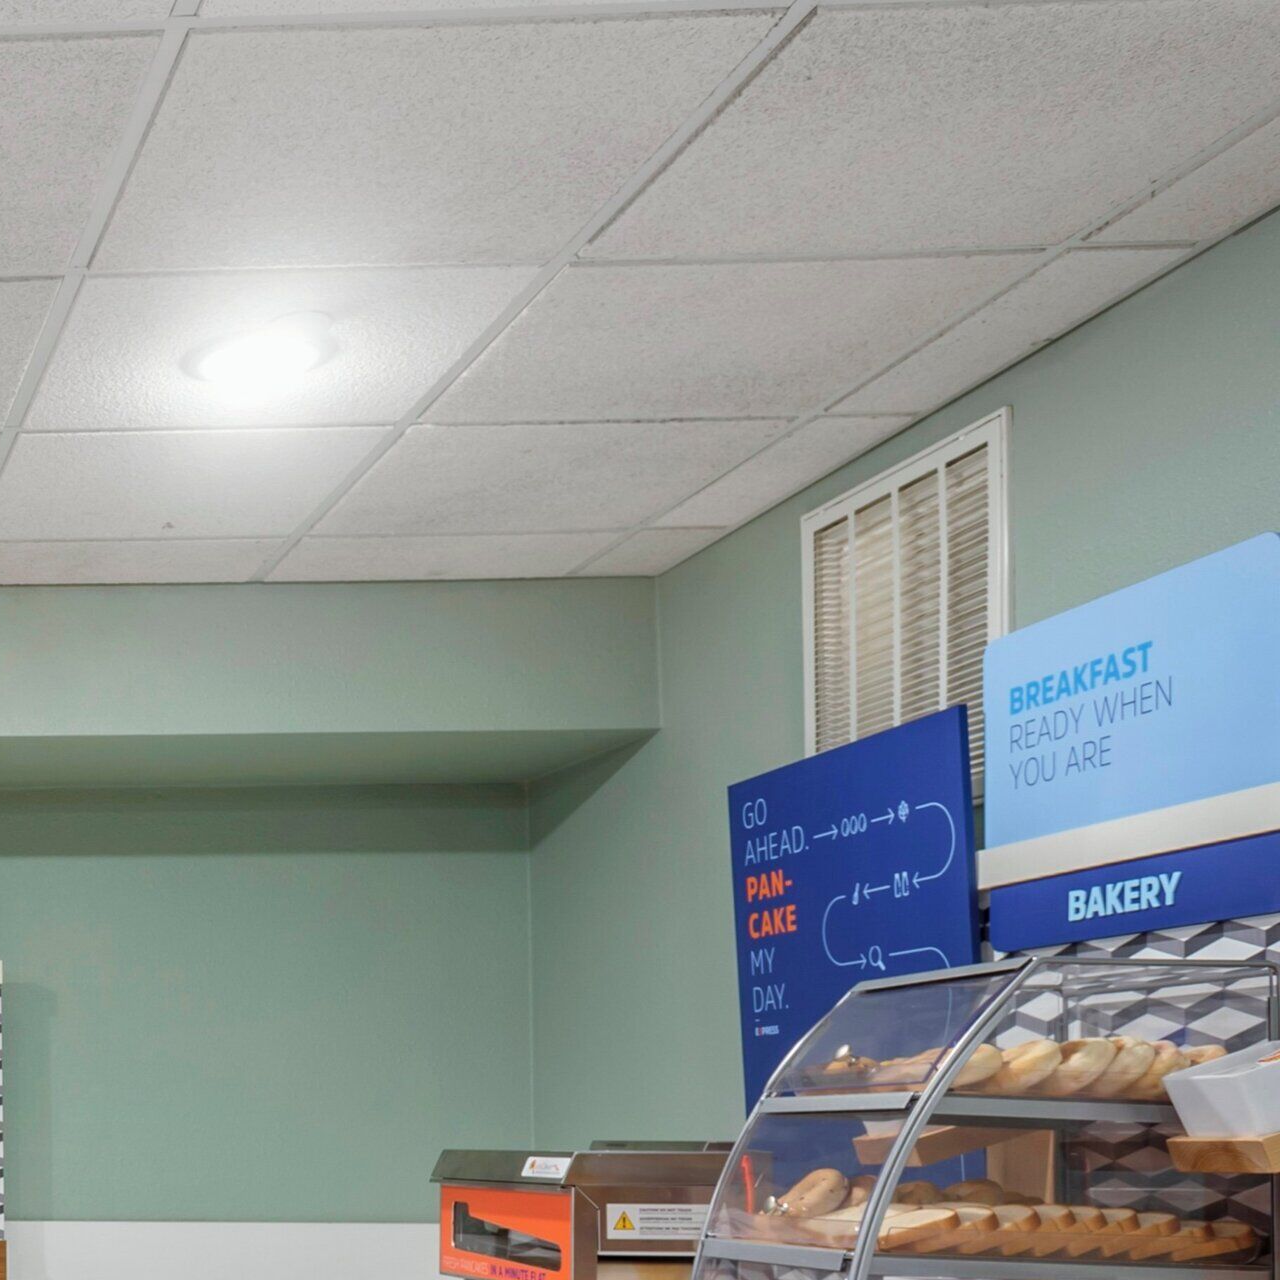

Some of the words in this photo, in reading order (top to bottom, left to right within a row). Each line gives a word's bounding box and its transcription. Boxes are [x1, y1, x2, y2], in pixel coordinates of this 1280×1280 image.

[1009, 640, 1153, 715] BREAKFAST
[1009, 703, 1085, 753] READY
[1093, 675, 1173, 728] WHEN
[1009, 752, 1057, 790] YOU
[1064, 735, 1112, 776] ARE
[742, 798, 767, 830] GO
[745, 825, 810, 867] AHEAD.
[745, 869, 794, 903] PAN-
[1068, 871, 1182, 922] BAKERY
[748, 904, 798, 940] CAKE
[750, 947, 775, 977] MY
[752, 982, 790, 1014] DAY.
